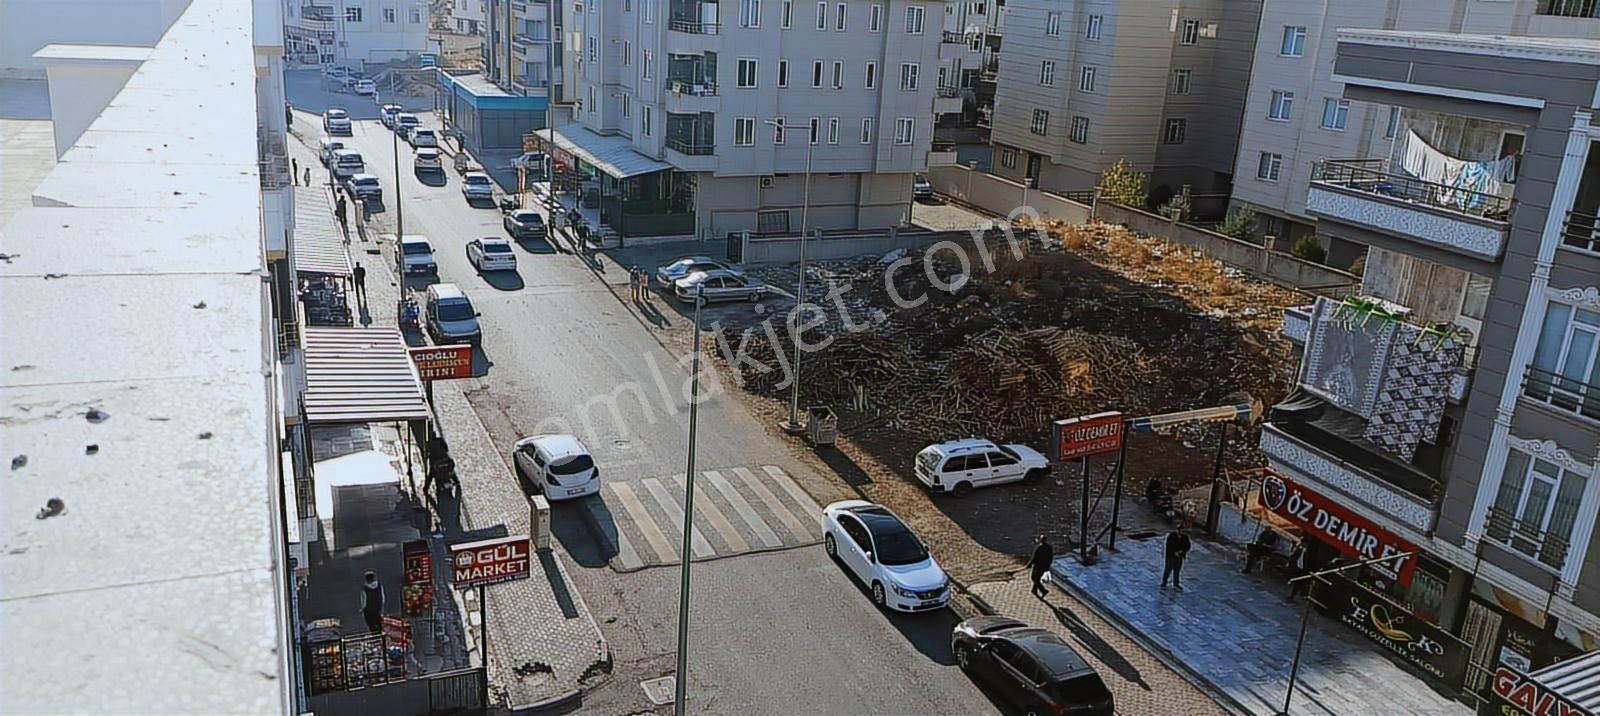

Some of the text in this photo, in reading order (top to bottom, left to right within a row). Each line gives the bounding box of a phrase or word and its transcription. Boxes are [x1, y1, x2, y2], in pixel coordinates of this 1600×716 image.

[413, 350, 458, 361] CIOĞLU
[1286, 489, 1314, 523] ÖZ
[1313, 508, 1378, 559] DEMİR
[1379, 543, 1411, 573] ET
[477, 543, 527, 564] GÜL
[456, 559, 527, 582] MARKET
